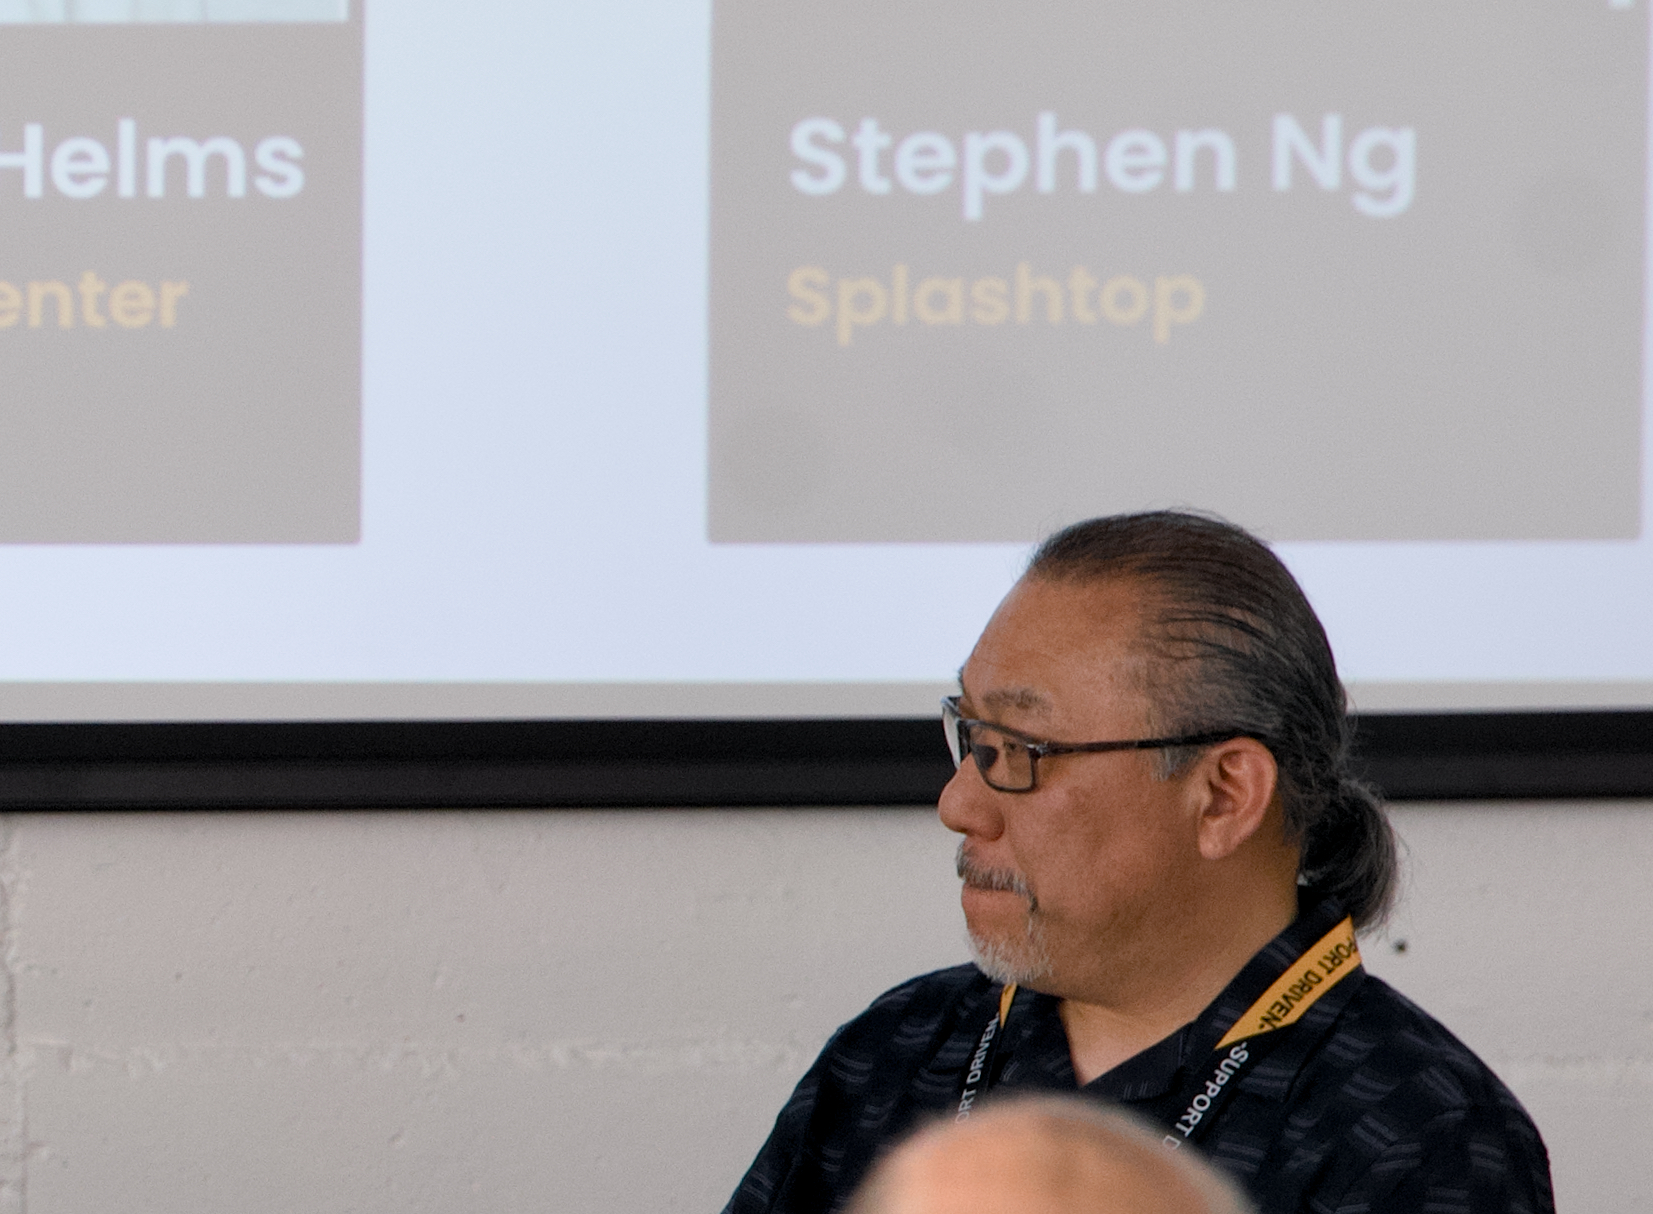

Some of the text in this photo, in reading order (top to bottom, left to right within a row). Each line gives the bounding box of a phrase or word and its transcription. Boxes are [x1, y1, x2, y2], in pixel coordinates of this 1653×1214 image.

[788, 112, 1417, 221] Stephen Ng
[786, 262, 1207, 347] Splashtop
[1175, 1041, 1250, 1138] -SUPPORT
